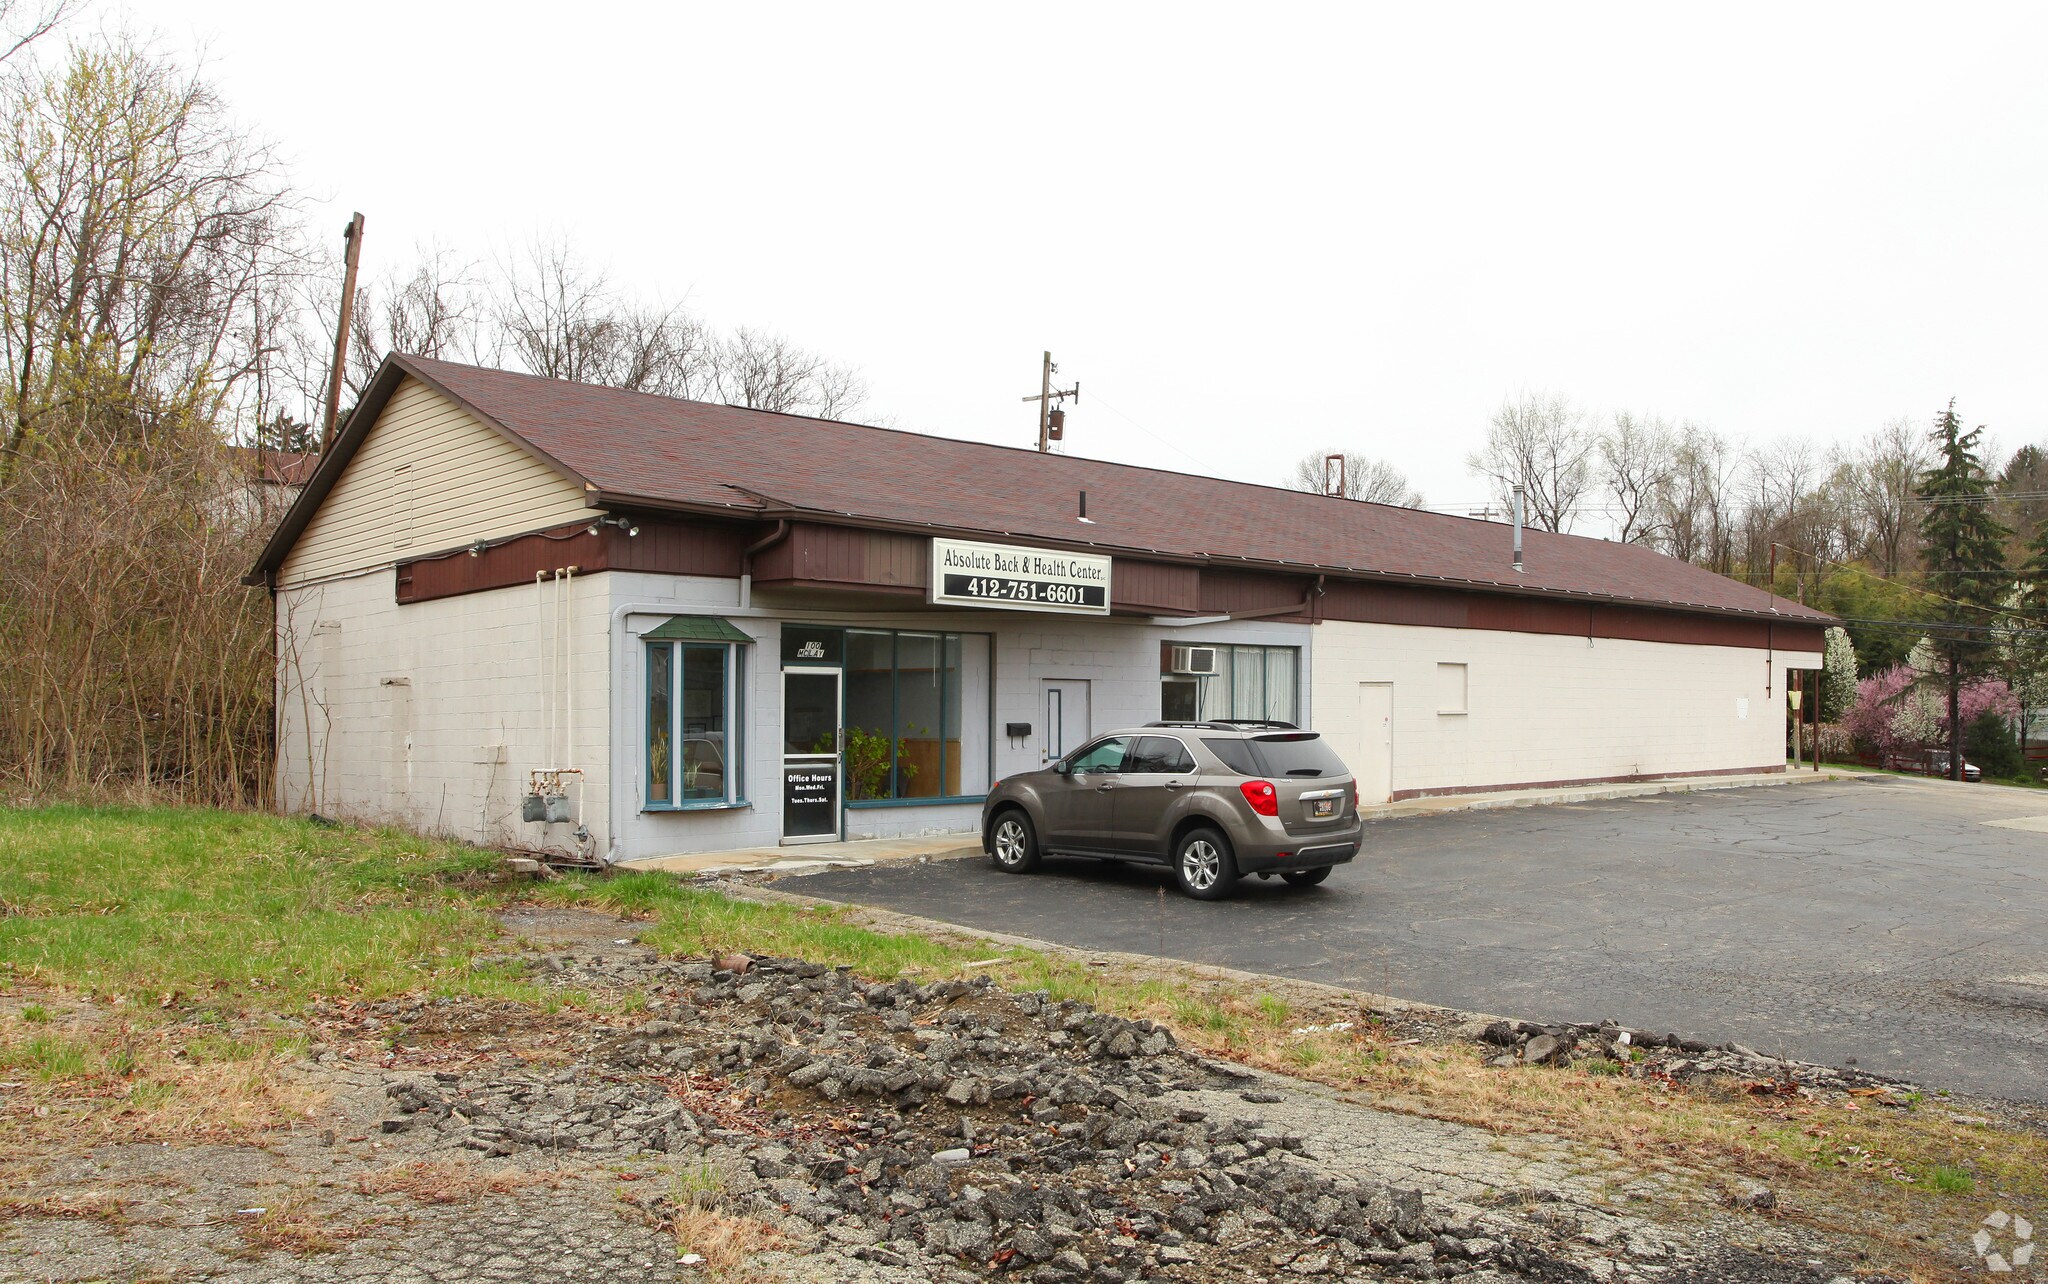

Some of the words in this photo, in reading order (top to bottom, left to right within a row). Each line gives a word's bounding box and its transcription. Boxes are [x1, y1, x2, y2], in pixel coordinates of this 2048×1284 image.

[944, 548, 991, 570] Absolute
[994, 553, 1019, 573] Back
[1022, 556, 1031, 574] &
[1034, 557, 1066, 577] Health
[1069, 561, 1101, 580] Center
[967, 577, 1085, 604] 412-751-6601
[806, 642, 821, 650] 100
[788, 774, 810, 783] Office
[812, 773, 832, 782] Hours
